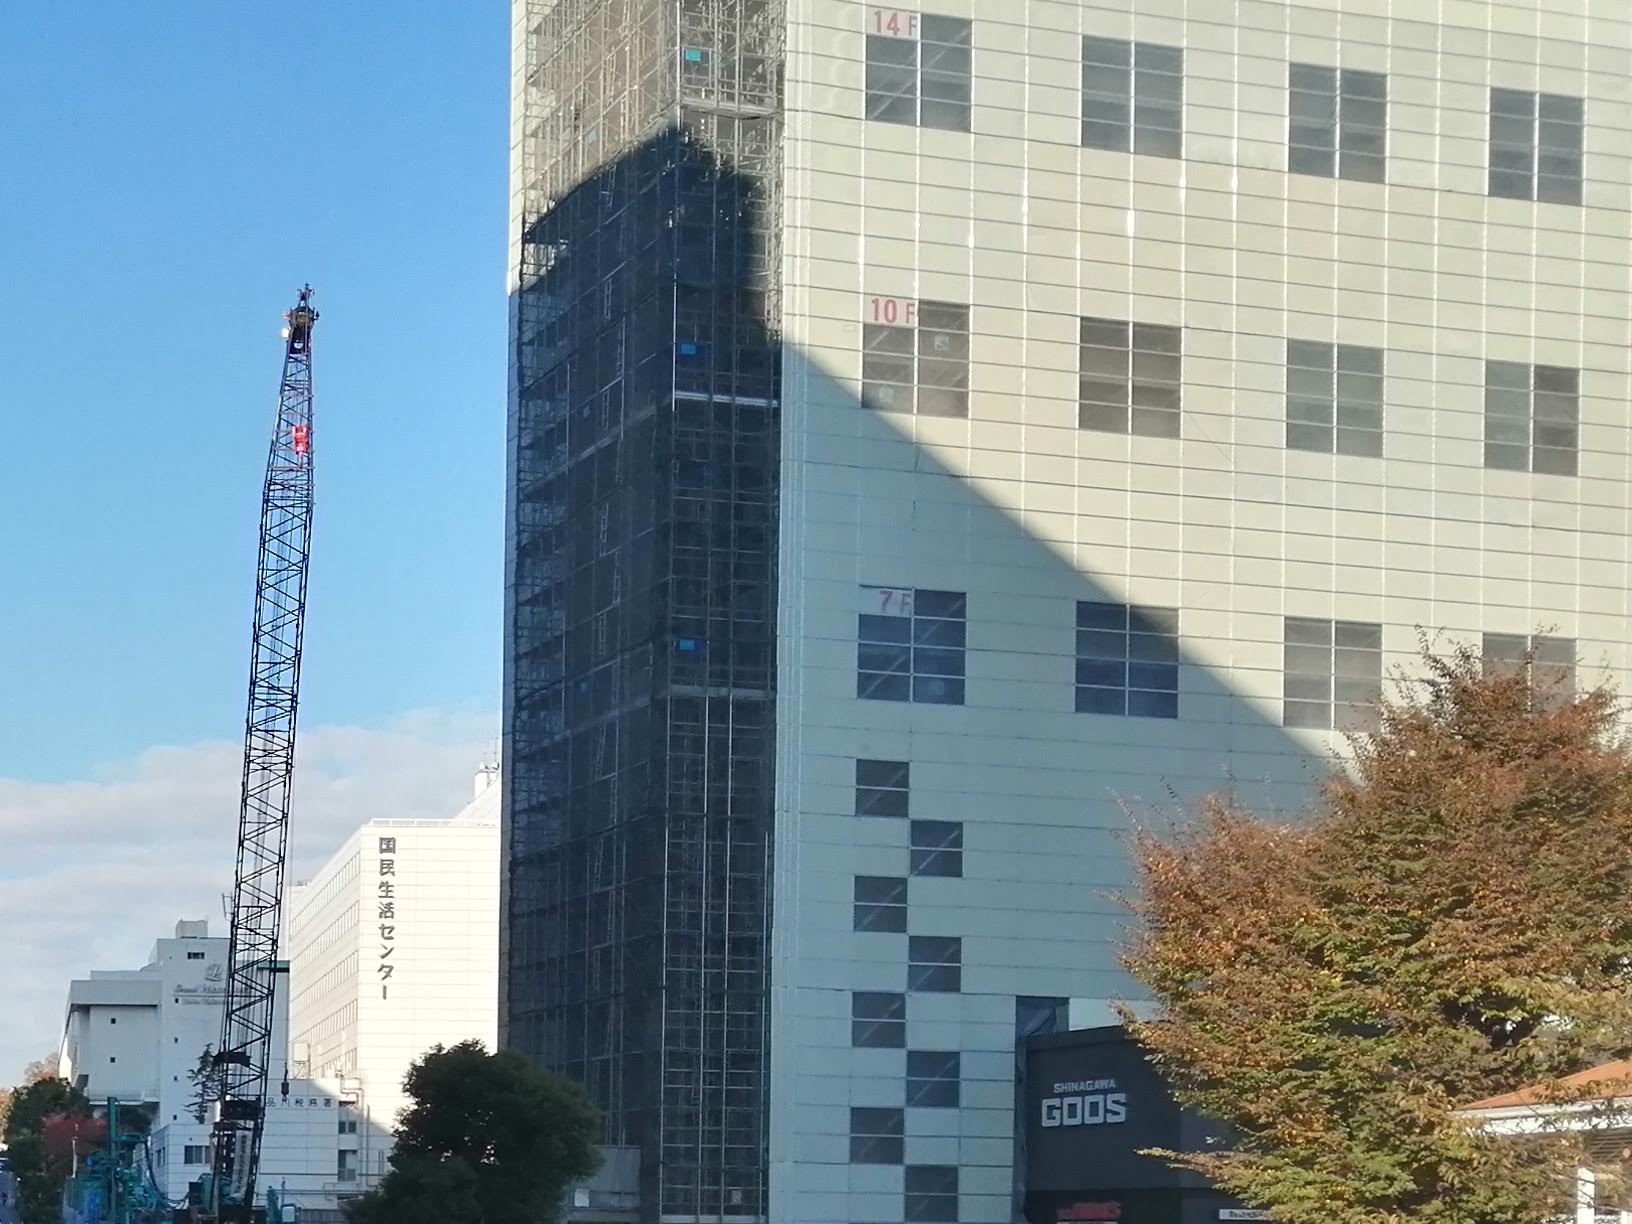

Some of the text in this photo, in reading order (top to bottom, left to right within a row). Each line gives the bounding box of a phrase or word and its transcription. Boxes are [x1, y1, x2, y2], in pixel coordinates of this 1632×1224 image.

[874, 10, 901, 35] 14
[871, 297, 898, 324] 10
[879, 590, 894, 613] 7
[377, 836, 397, 1001] 国民生活センター
[1053, 1078, 1117, 1093] SHINAGAWA
[1041, 1092, 1128, 1127] GOOS
